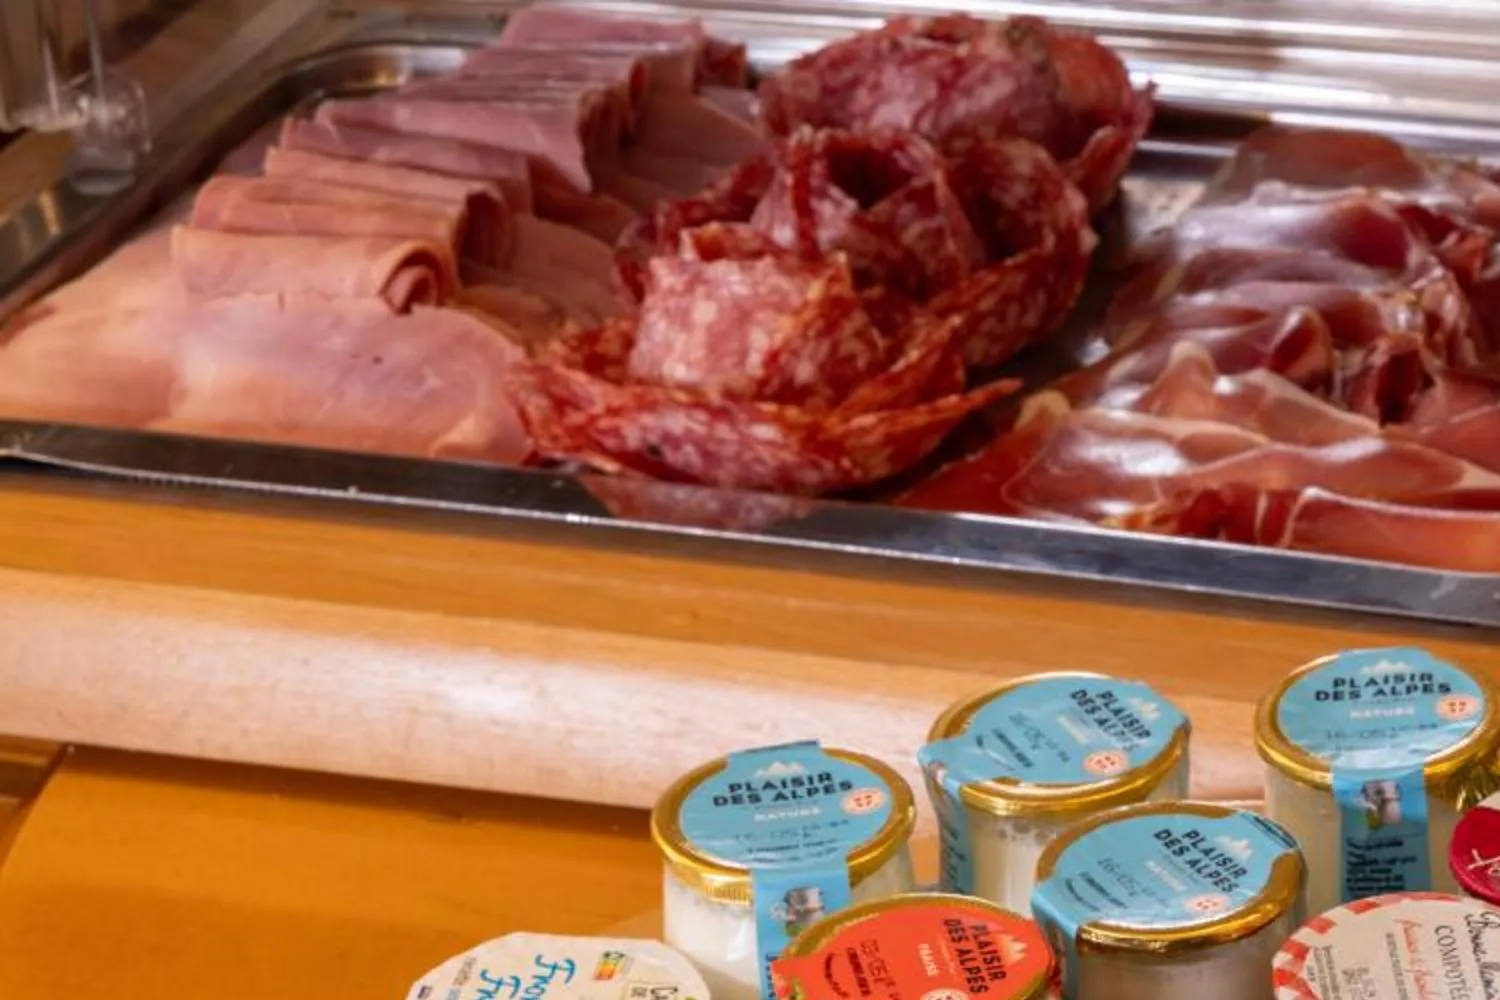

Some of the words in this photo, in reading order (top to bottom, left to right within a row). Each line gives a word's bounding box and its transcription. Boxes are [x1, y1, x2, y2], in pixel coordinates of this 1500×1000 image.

[1315, 689, 1361, 702] DES
[1372, 683, 1452, 698] ALPES
[1333, 672, 1433, 689] PLAISIR
[1069, 689, 1096, 716] DES
[1095, 690, 1152, 739] PLAISIR
[713, 793, 762, 807] DES
[772, 780, 854, 803] ALPES
[728, 771, 833, 793] PLAISIR
[1153, 829, 1191, 858] DES
[1186, 857, 1240, 894] ALPES
[1181, 830, 1248, 880] PLAISIR
[944, 918, 963, 943] DES
[954, 948, 989, 994] ALPES
[970, 924, 1007, 982] PLAISIR
